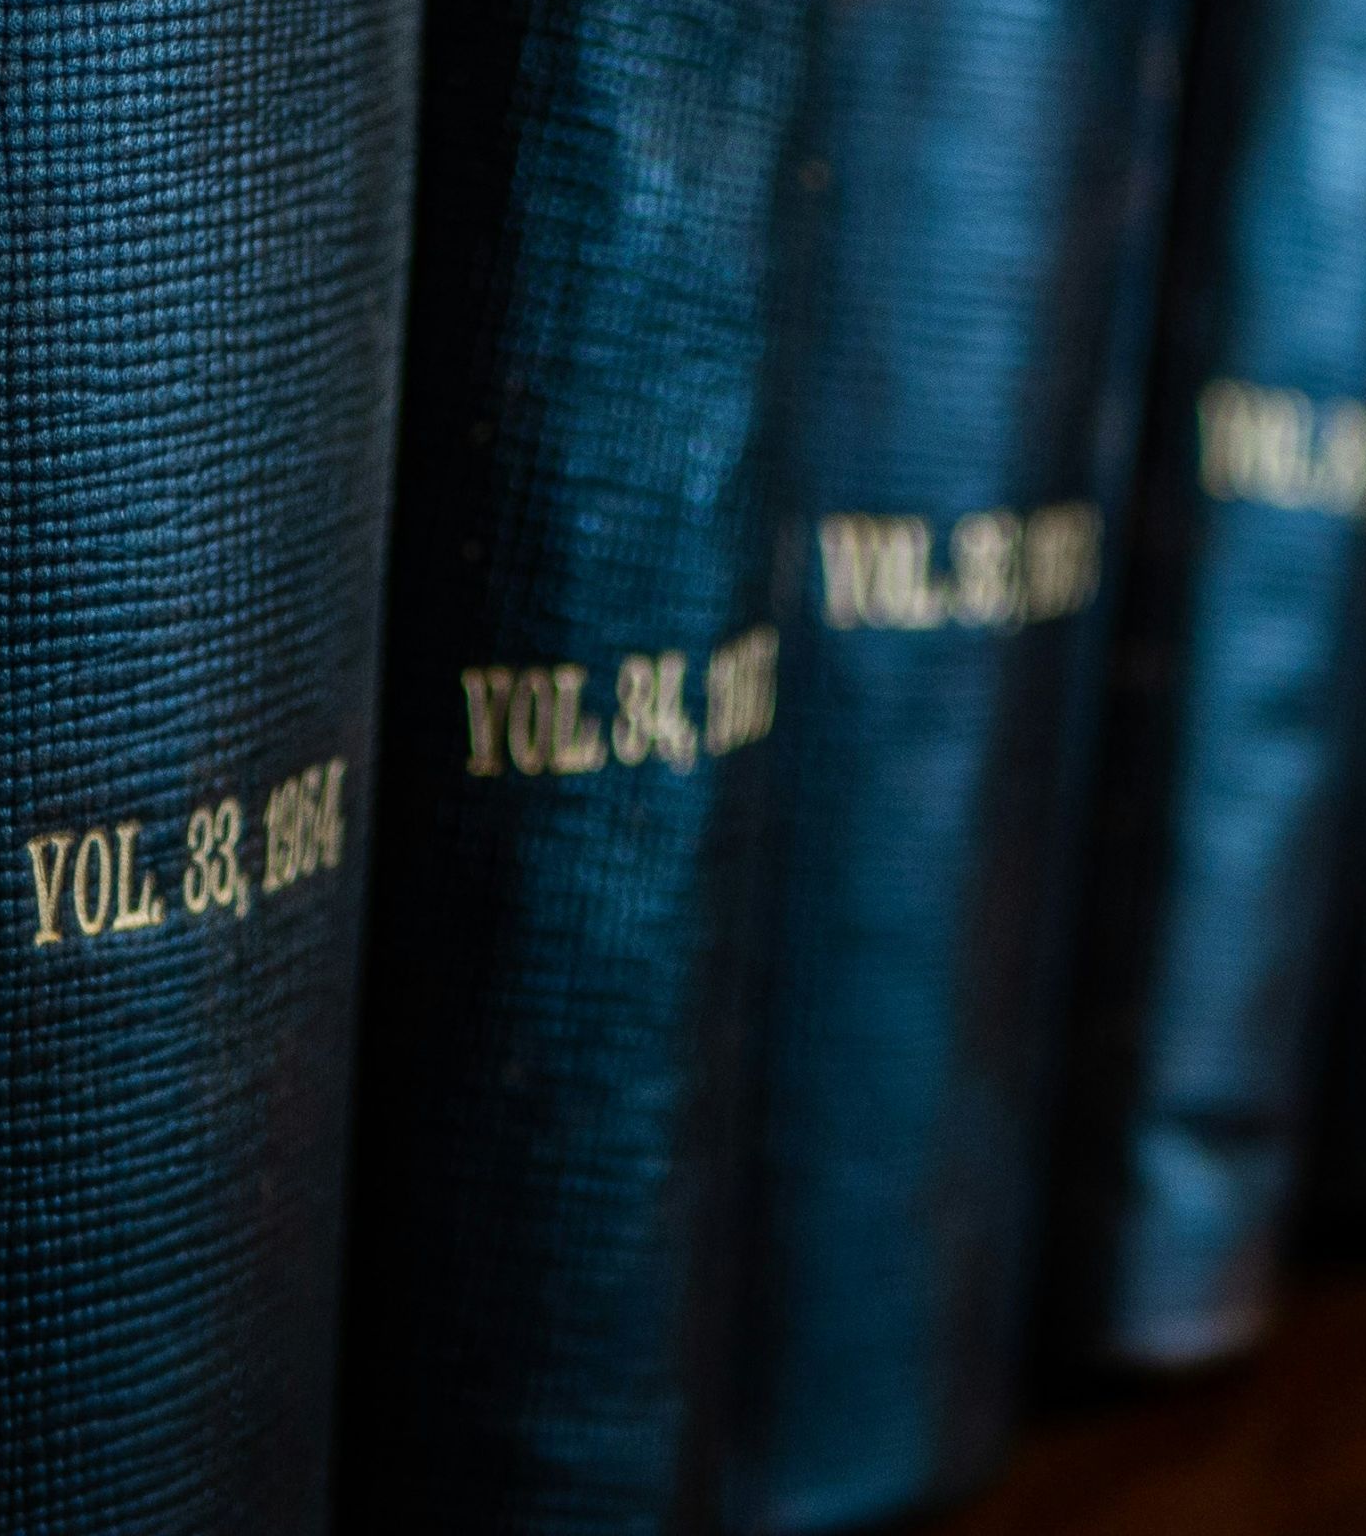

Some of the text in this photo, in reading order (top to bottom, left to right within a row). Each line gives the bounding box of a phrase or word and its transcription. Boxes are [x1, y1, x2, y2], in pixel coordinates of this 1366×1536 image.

[27, 757, 347, 947] VOL. 33, 1954
